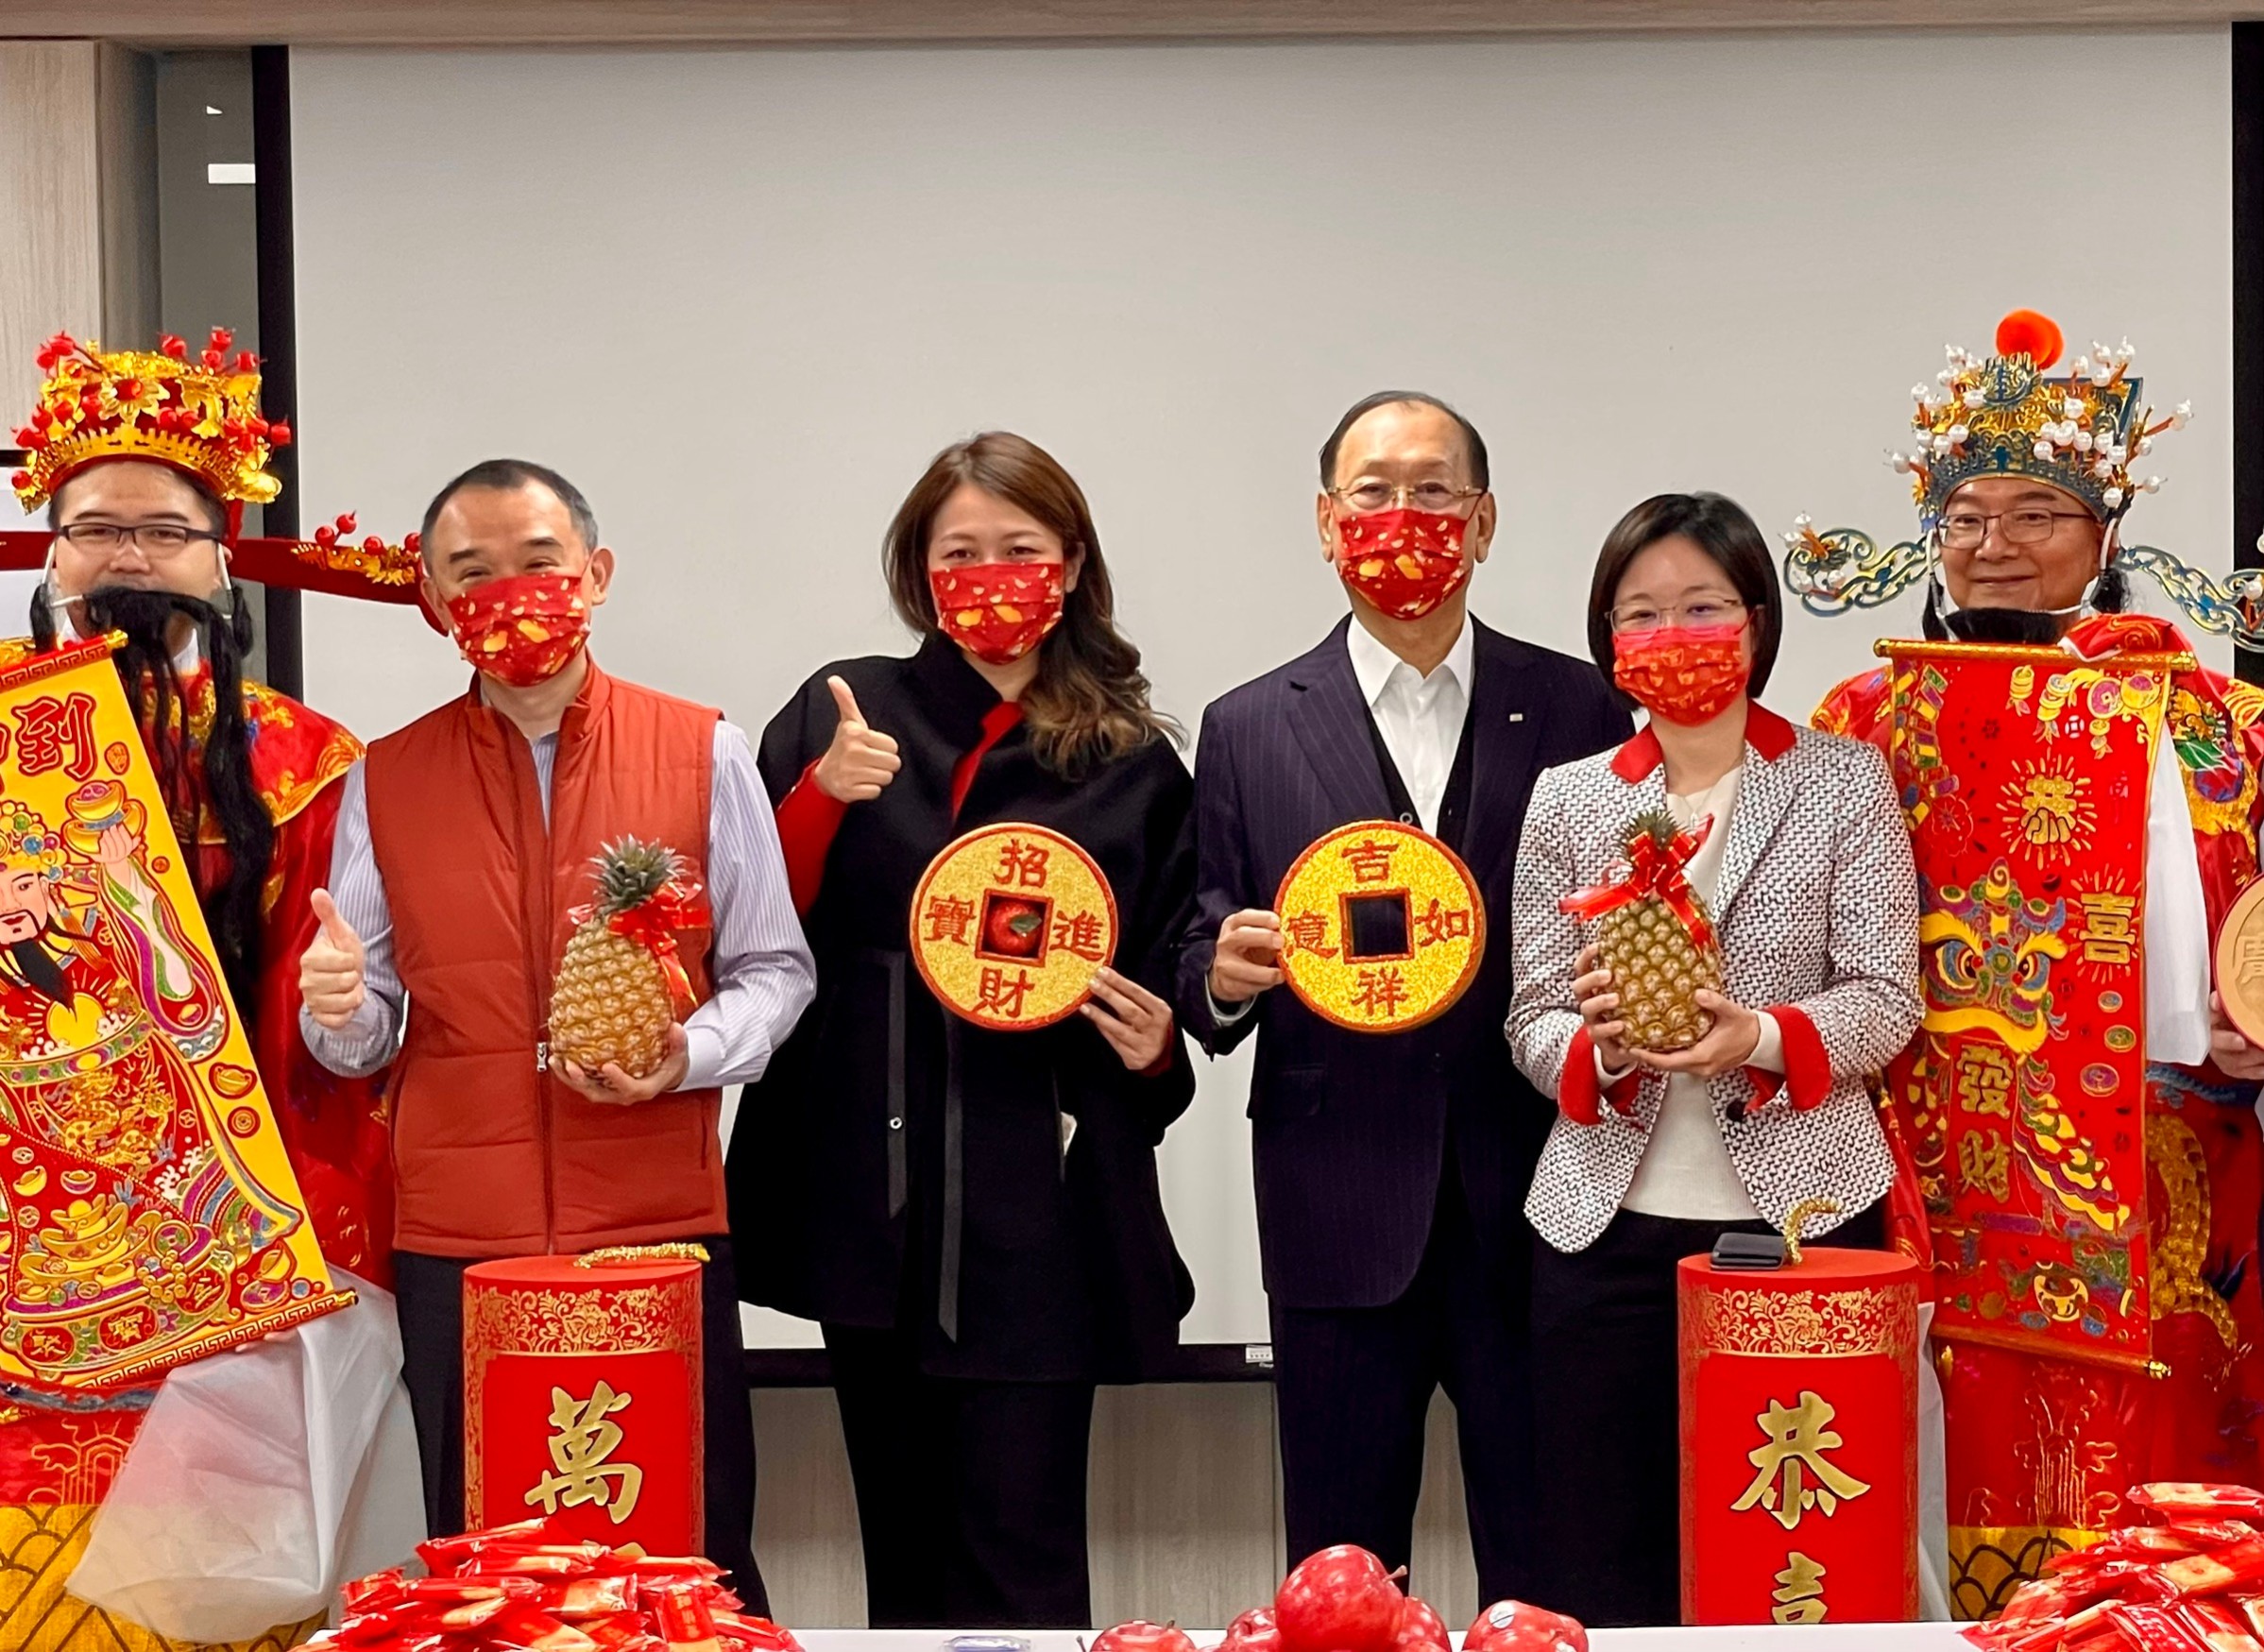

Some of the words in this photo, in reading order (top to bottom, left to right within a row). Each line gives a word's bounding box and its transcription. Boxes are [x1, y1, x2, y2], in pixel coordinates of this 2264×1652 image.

[0, 692, 98, 795] 到
[2020, 774, 2077, 844] 恭
[994, 839, 1050, 888] 招
[1341, 840, 1400, 883] 吉
[924, 894, 976, 945] 寶
[1048, 910, 1104, 962] 進
[1285, 910, 1339, 959] 意
[1414, 898, 1470, 947] 如
[2079, 892, 2136, 964] 喜
[972, 967, 1035, 1018] 財
[1351, 967, 1407, 1016] 祥
[1957, 1044, 2013, 1203] 發財
[524, 1380, 647, 1557] 萬
